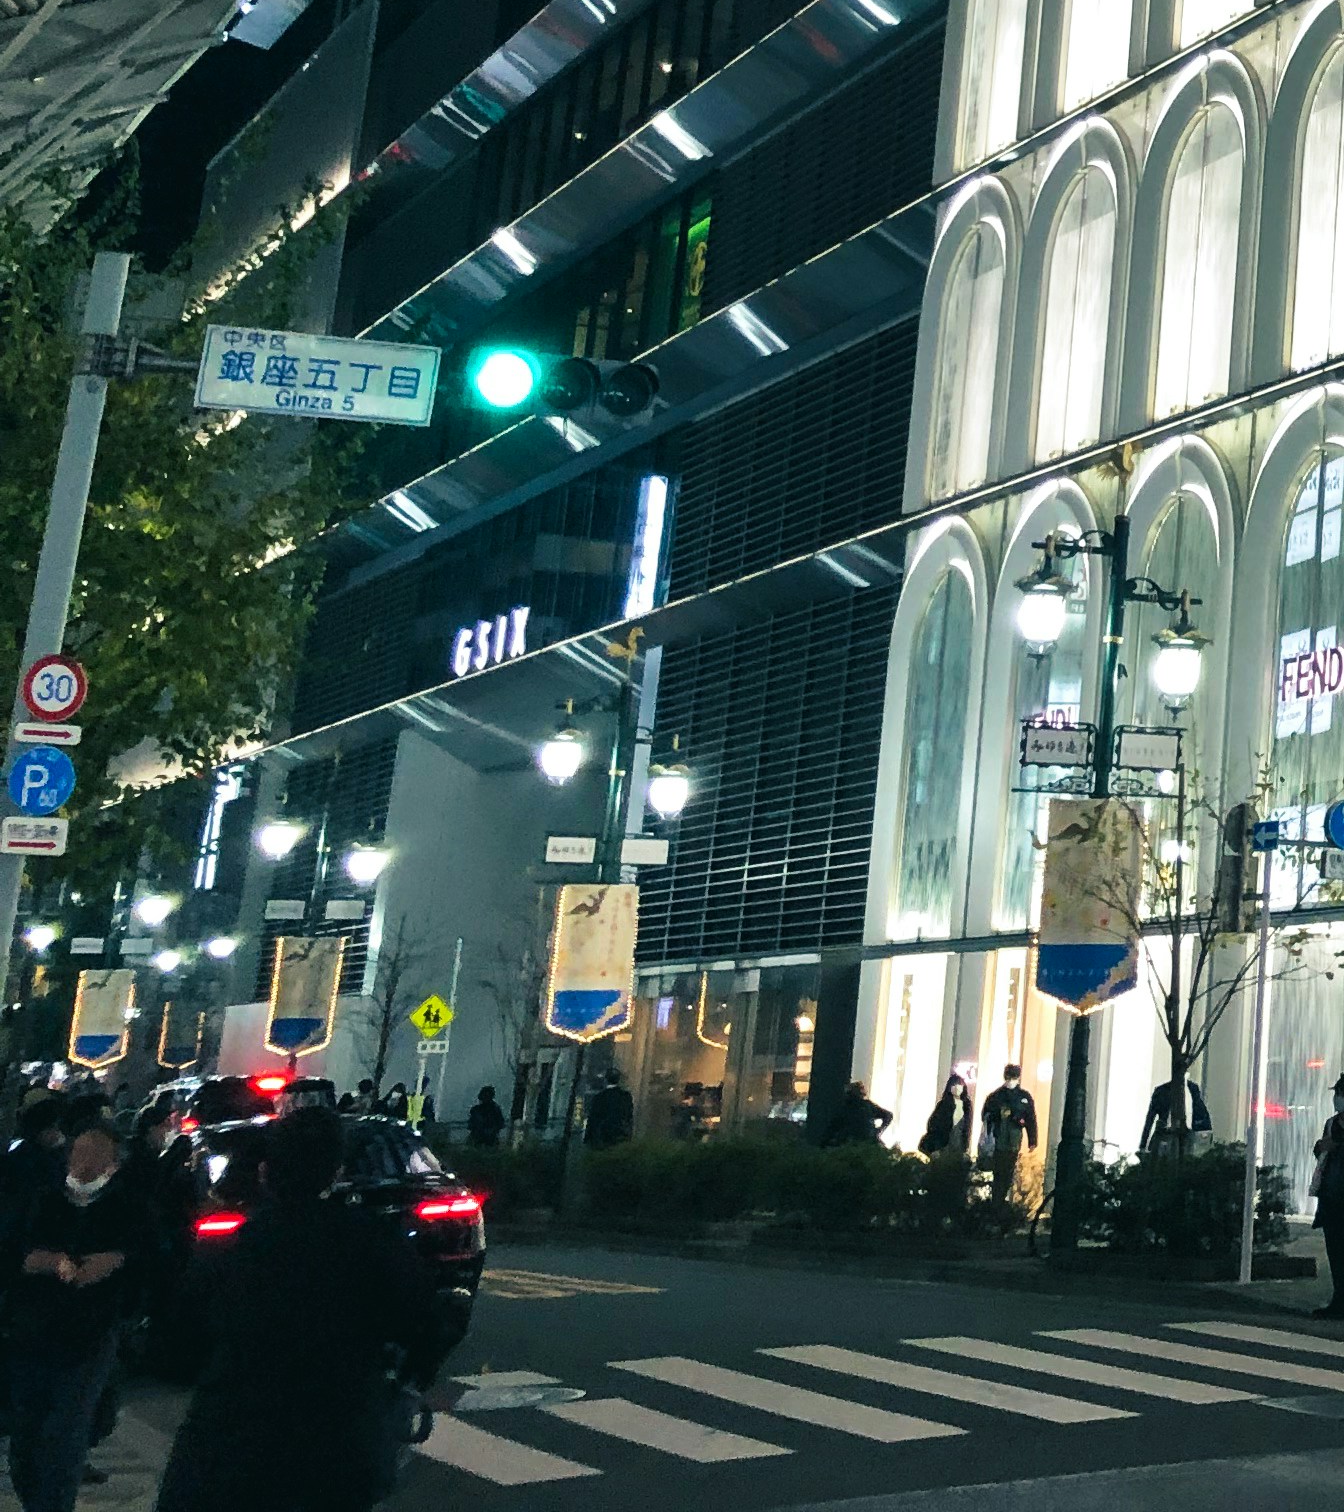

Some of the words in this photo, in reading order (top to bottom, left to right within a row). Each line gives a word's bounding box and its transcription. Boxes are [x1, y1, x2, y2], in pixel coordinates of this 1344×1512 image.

[224, 330, 287, 351] 中央区
[218, 349, 421, 399] 銀座五丁目
[275, 389, 333, 410] Ginza
[342, 395, 355, 412] 5
[453, 606, 530, 677] GSIX
[37, 672, 73, 702] 30
[21, 764, 49, 807] P
